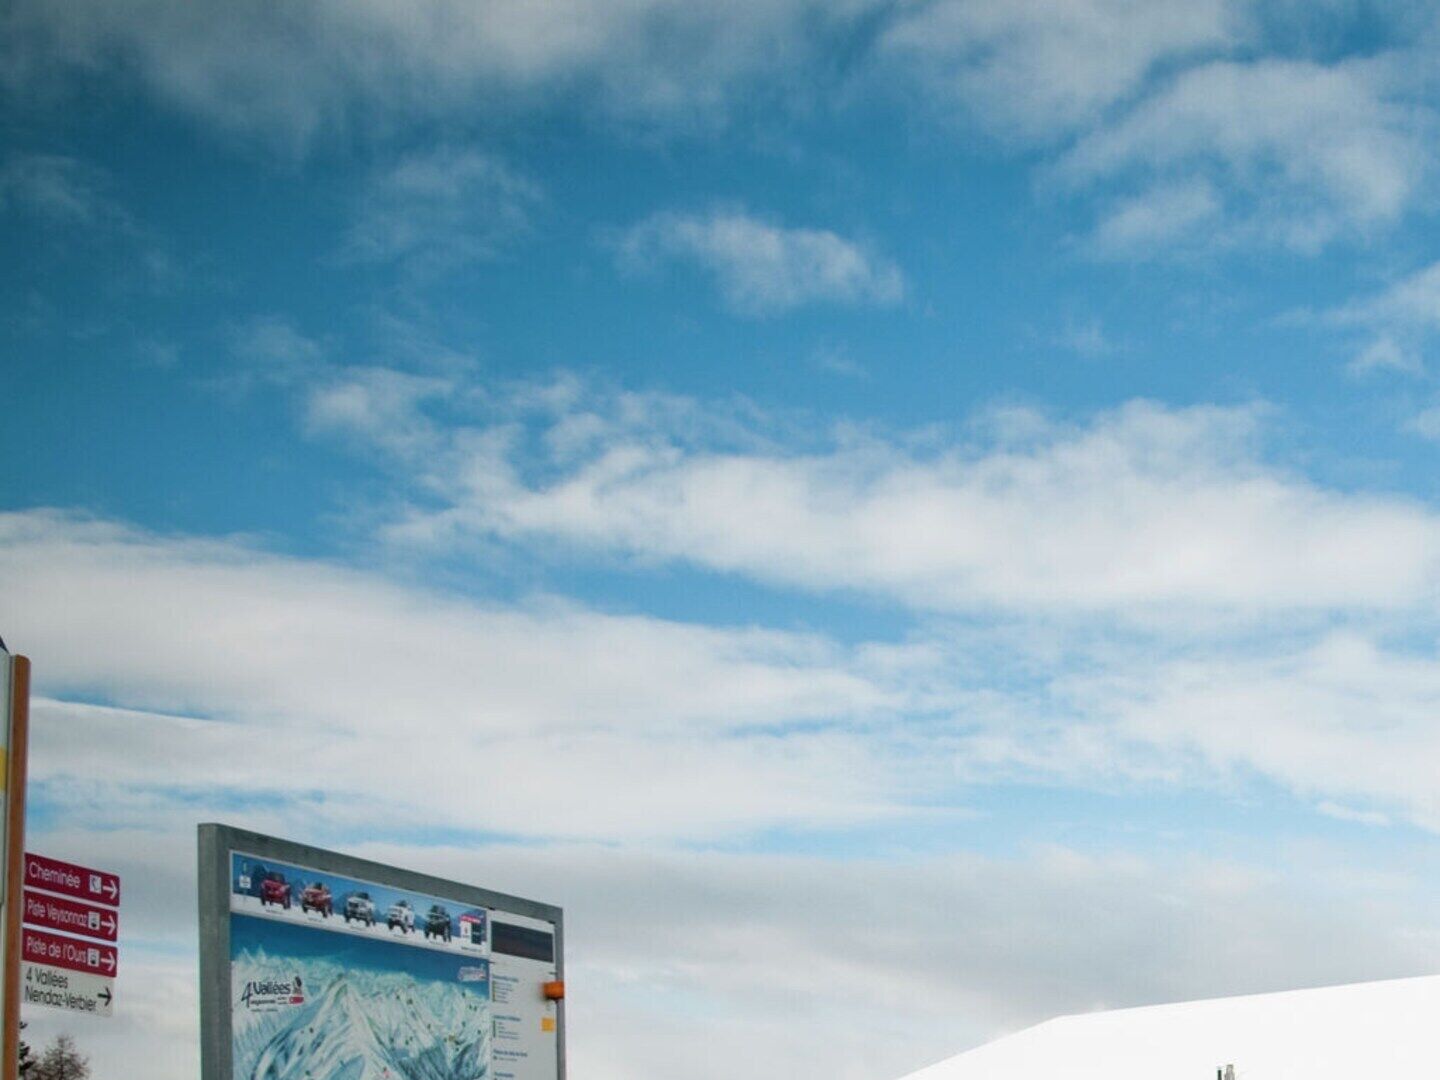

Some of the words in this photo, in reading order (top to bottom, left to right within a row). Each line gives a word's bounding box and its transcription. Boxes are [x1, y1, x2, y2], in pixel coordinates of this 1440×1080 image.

[29, 861, 80, 889] Cheminée
[27, 899, 46, 918] Piste
[27, 936, 46, 956] Piste
[48, 942, 61, 959] de
[26, 967, 32, 982] 4
[35, 967, 68, 989] Vallées
[25, 985, 97, 1012] Nendaz-Verbier
[241, 981, 253, 1009] 4
[252, 980, 291, 995] Vallées
